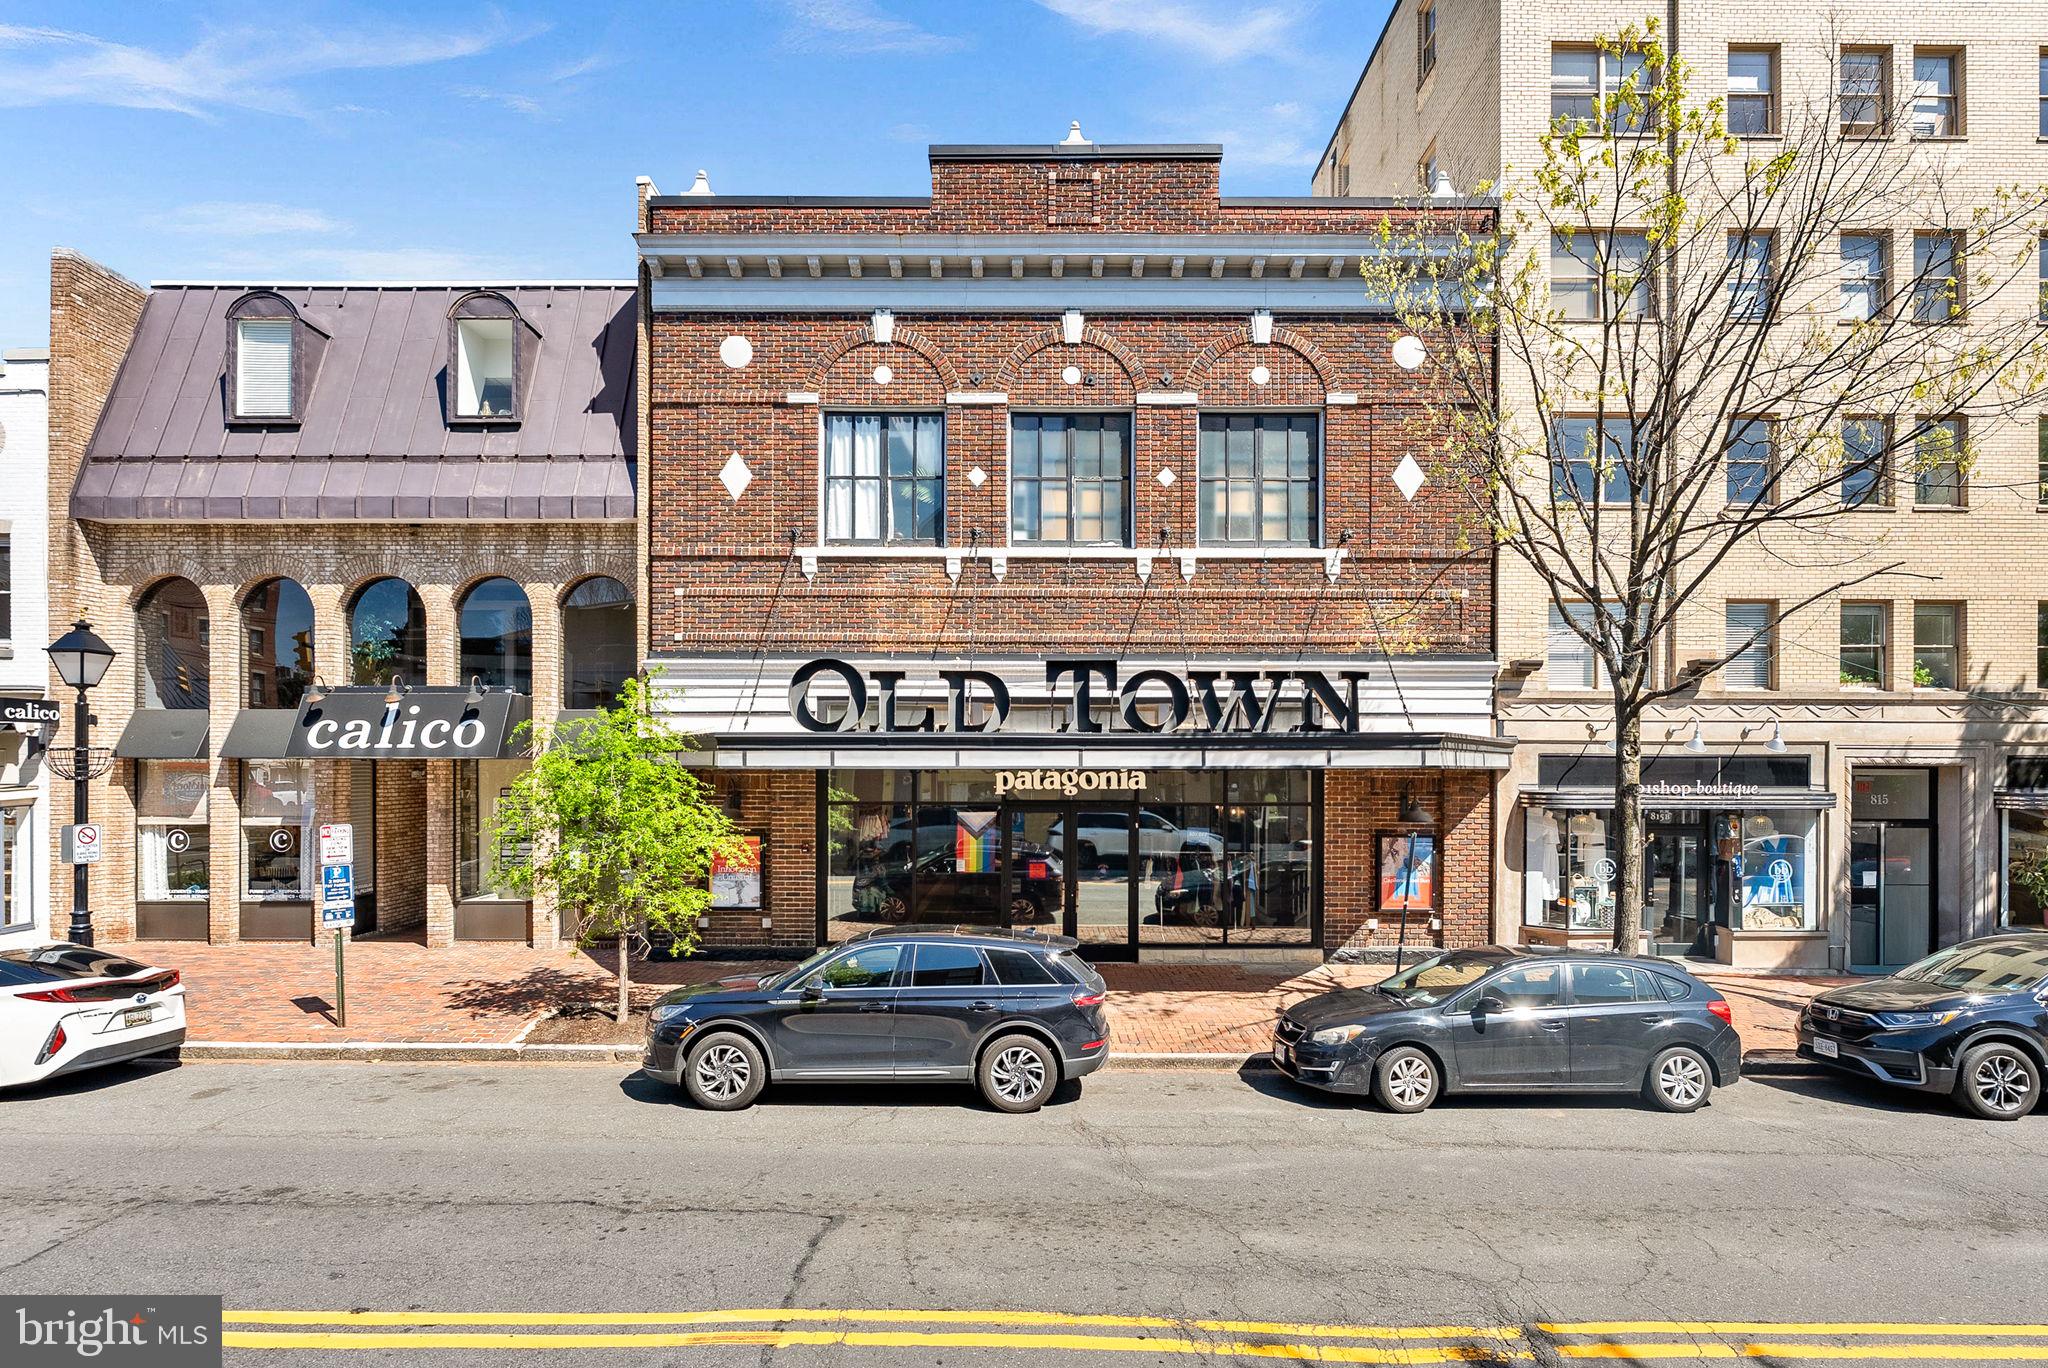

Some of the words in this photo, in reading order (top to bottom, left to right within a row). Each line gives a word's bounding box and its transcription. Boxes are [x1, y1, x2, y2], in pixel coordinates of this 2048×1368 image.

[789, 658, 1011, 733] OLD
[1046, 660, 1370, 733] TOWN
[4, 702, 60, 721] calico
[306, 701, 486, 750] calico
[995, 768, 1147, 796] patagonia
[1696, 779, 1759, 798] boutique
[1870, 793, 1889, 805] 815
